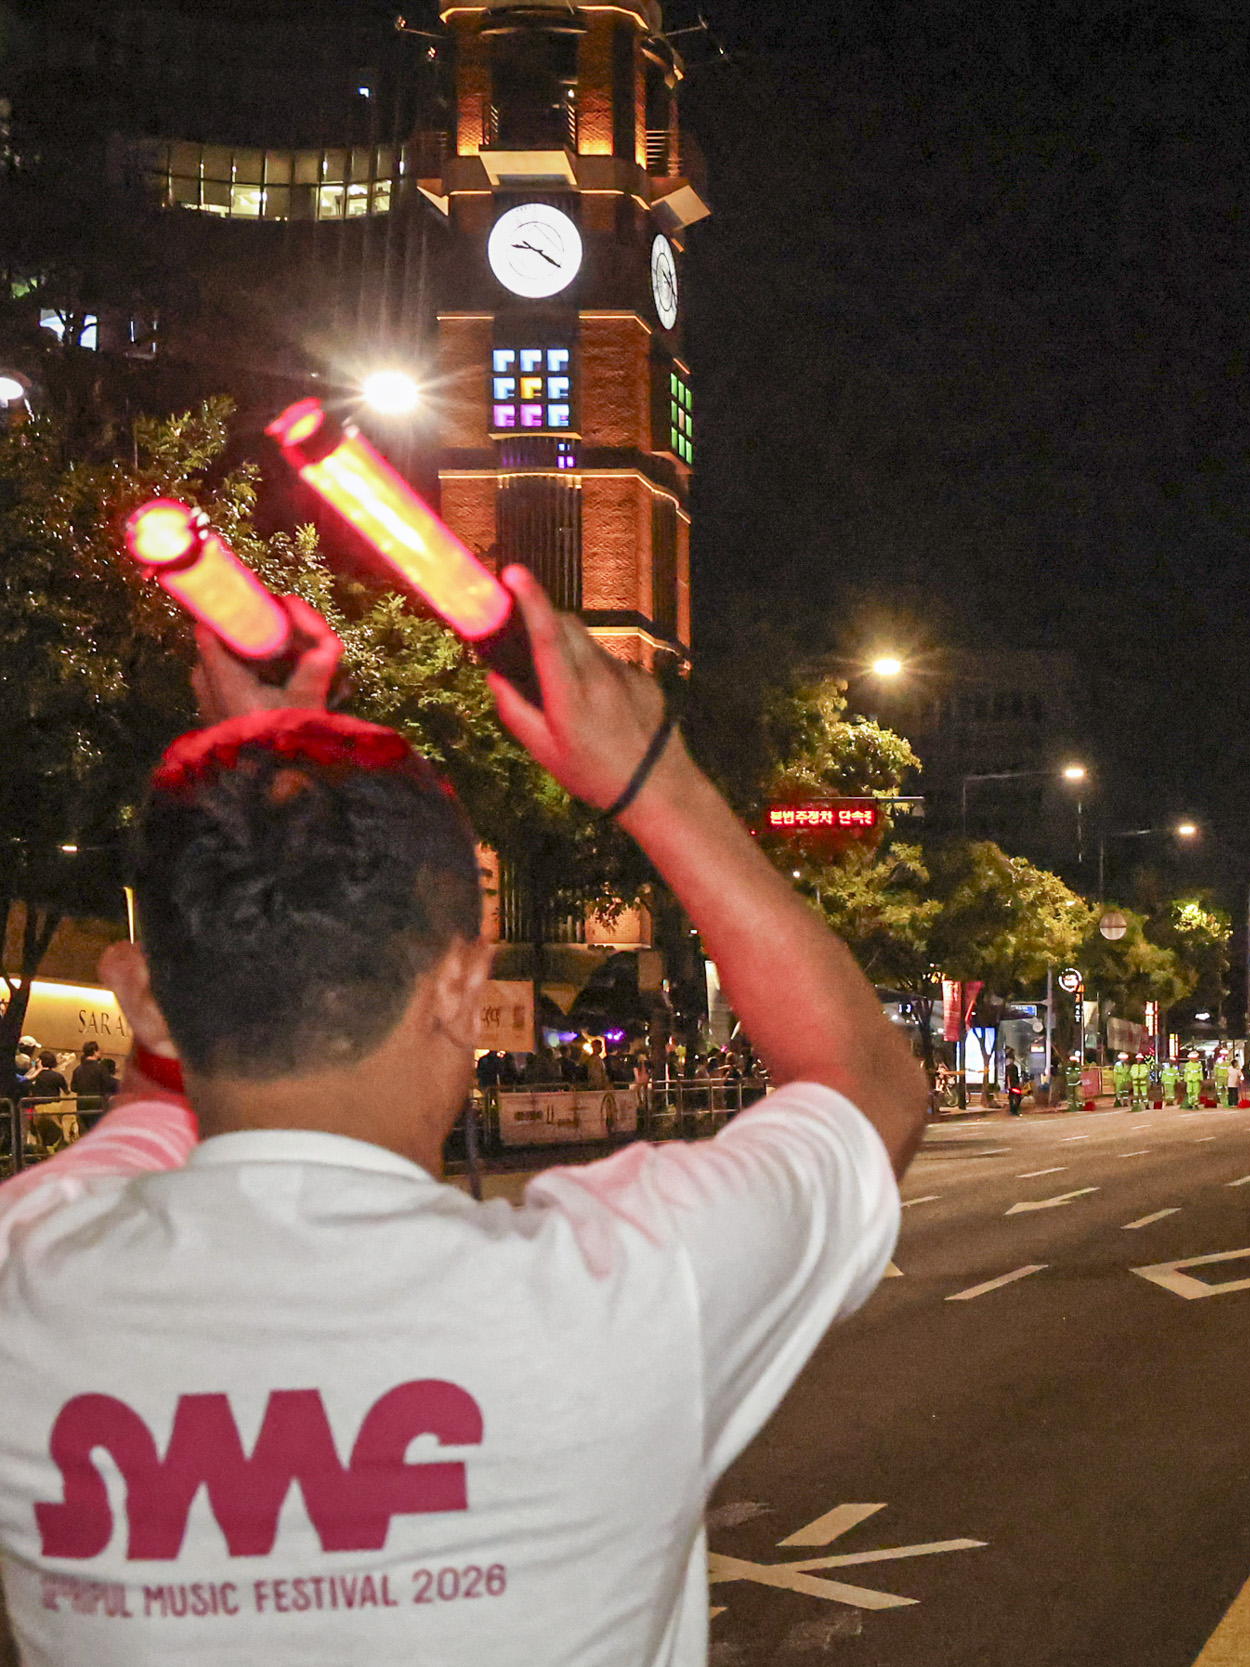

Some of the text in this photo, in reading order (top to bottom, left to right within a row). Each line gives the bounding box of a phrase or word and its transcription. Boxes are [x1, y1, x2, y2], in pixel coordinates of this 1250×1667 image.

[143, 1582, 239, 1618] MUSIC
[253, 1574, 399, 1613] FESTIVAL
[411, 1563, 508, 1605] 2026
